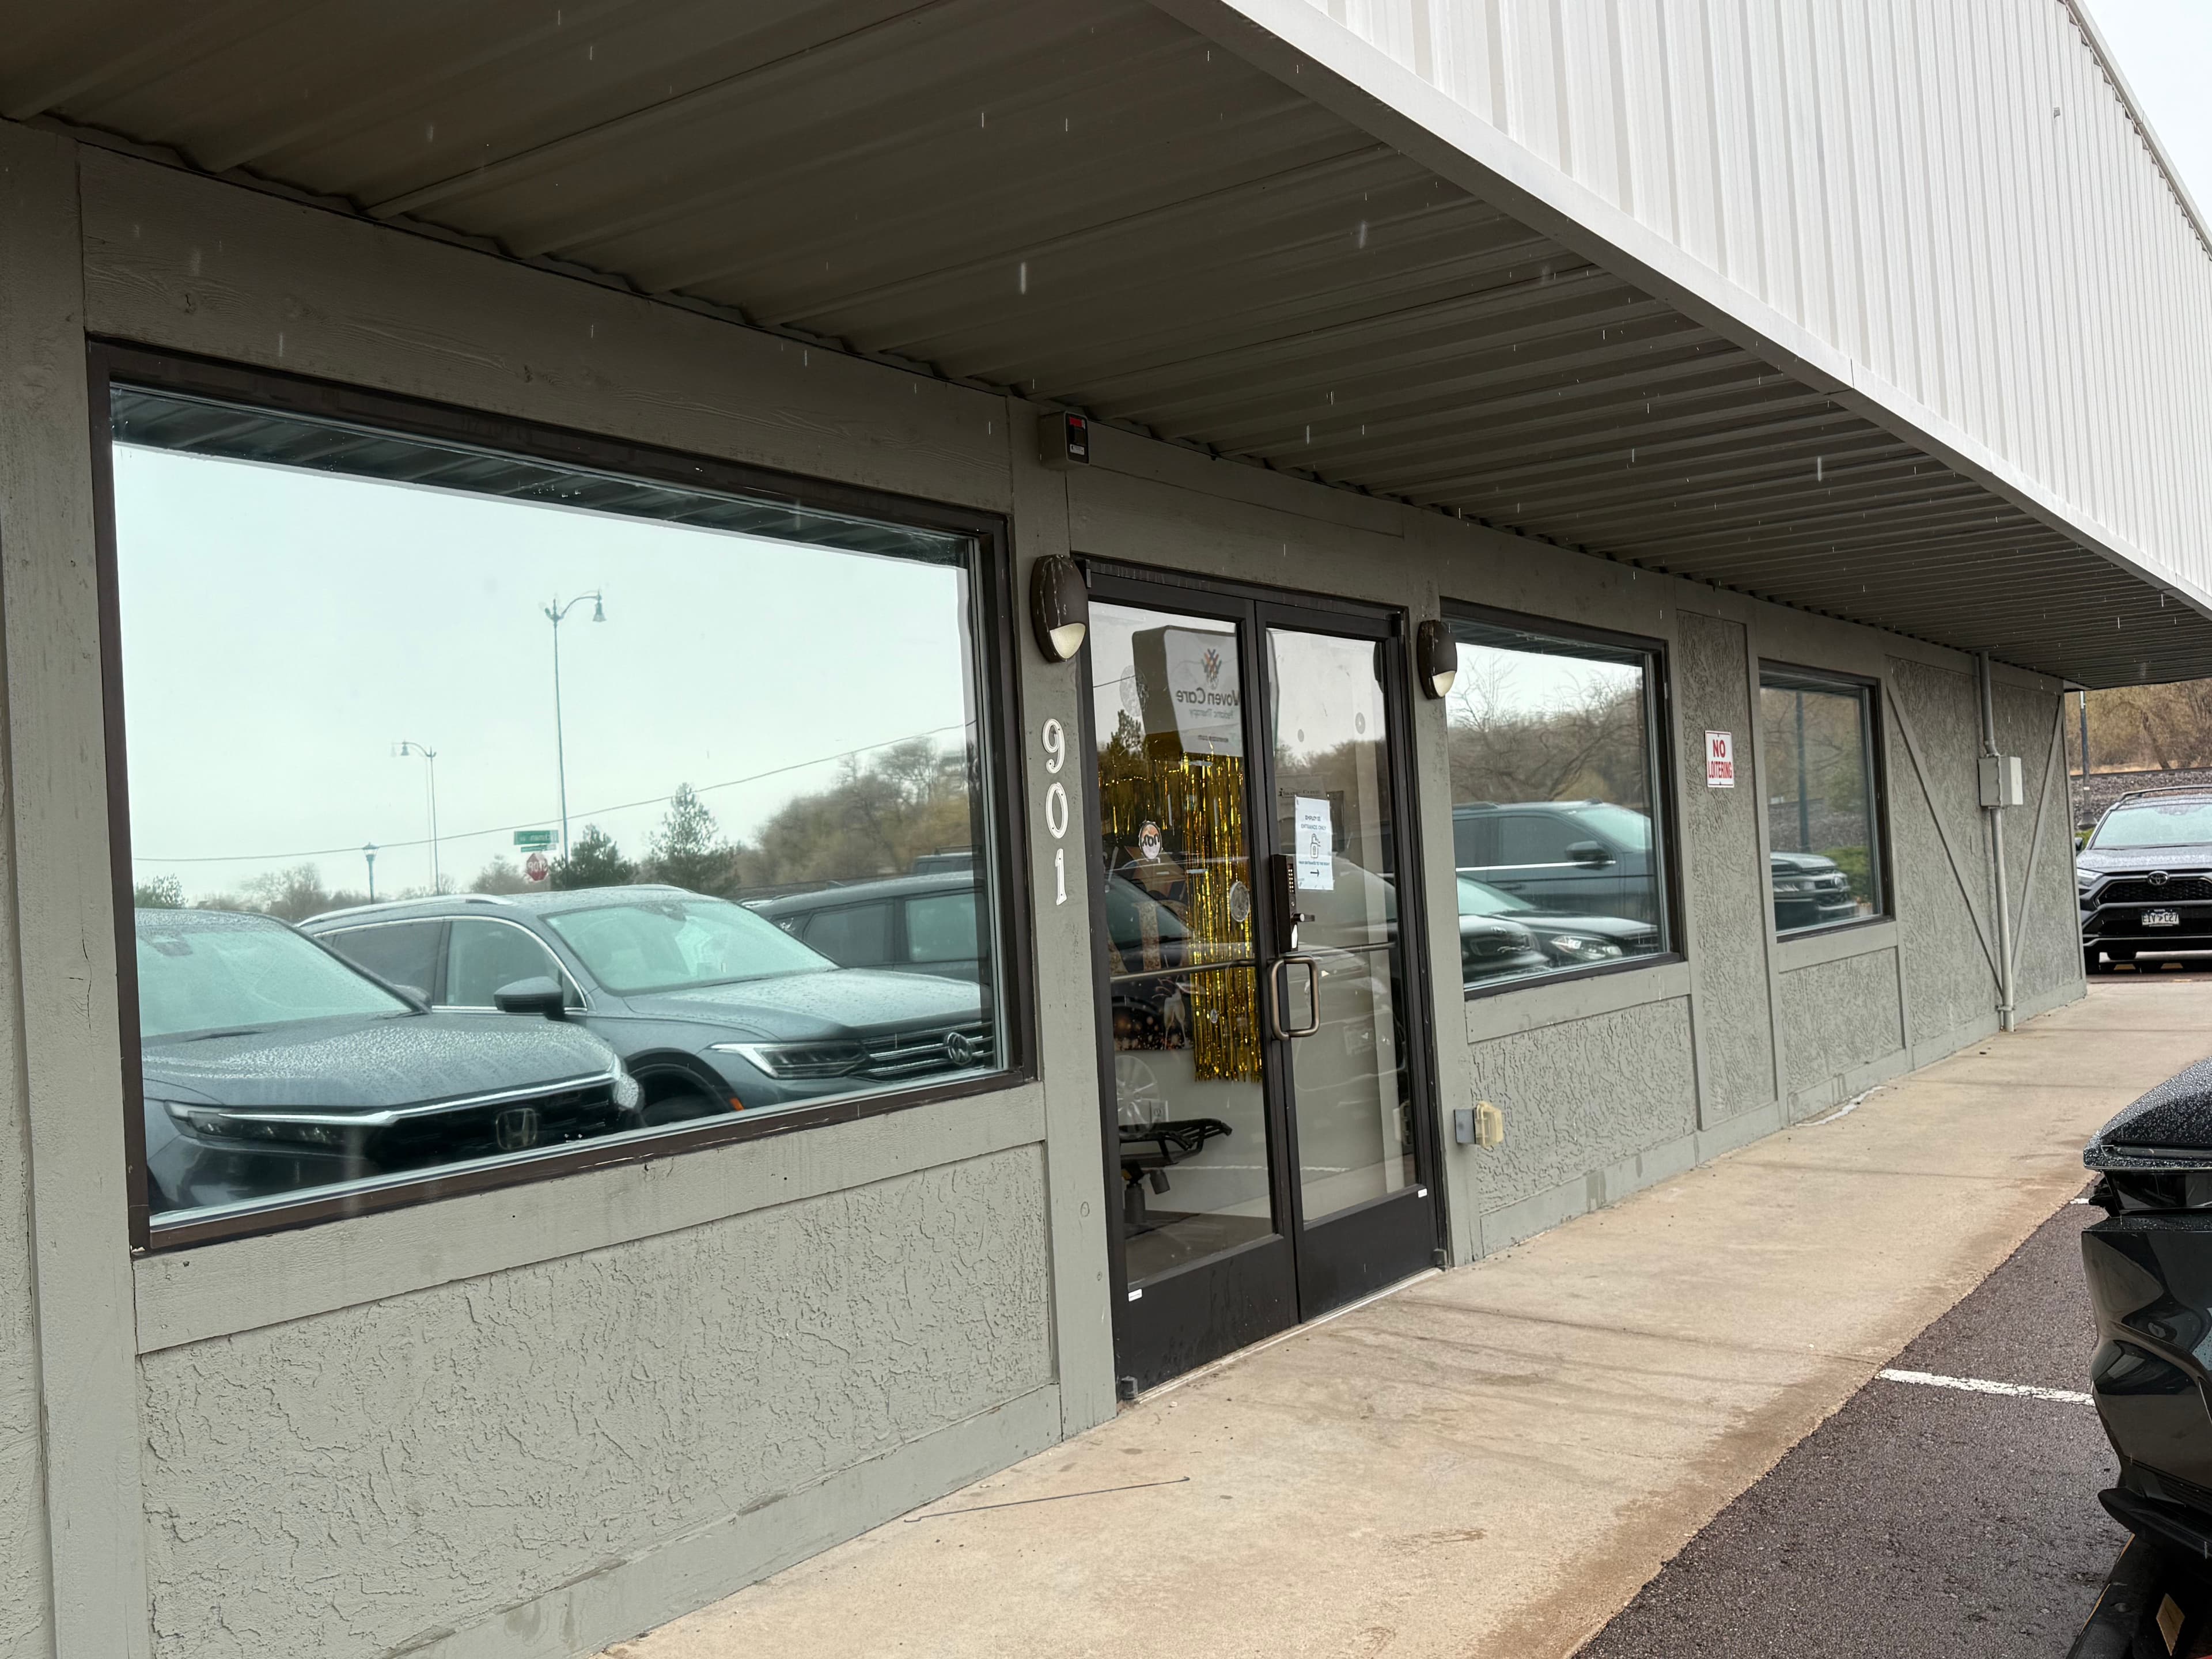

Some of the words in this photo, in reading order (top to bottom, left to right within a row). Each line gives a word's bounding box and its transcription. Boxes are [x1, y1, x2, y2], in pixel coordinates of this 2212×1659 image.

[1713, 739, 1726, 758] NO
[1708, 761, 1732, 779] LOITERING
[1042, 718, 1069, 906] 901
